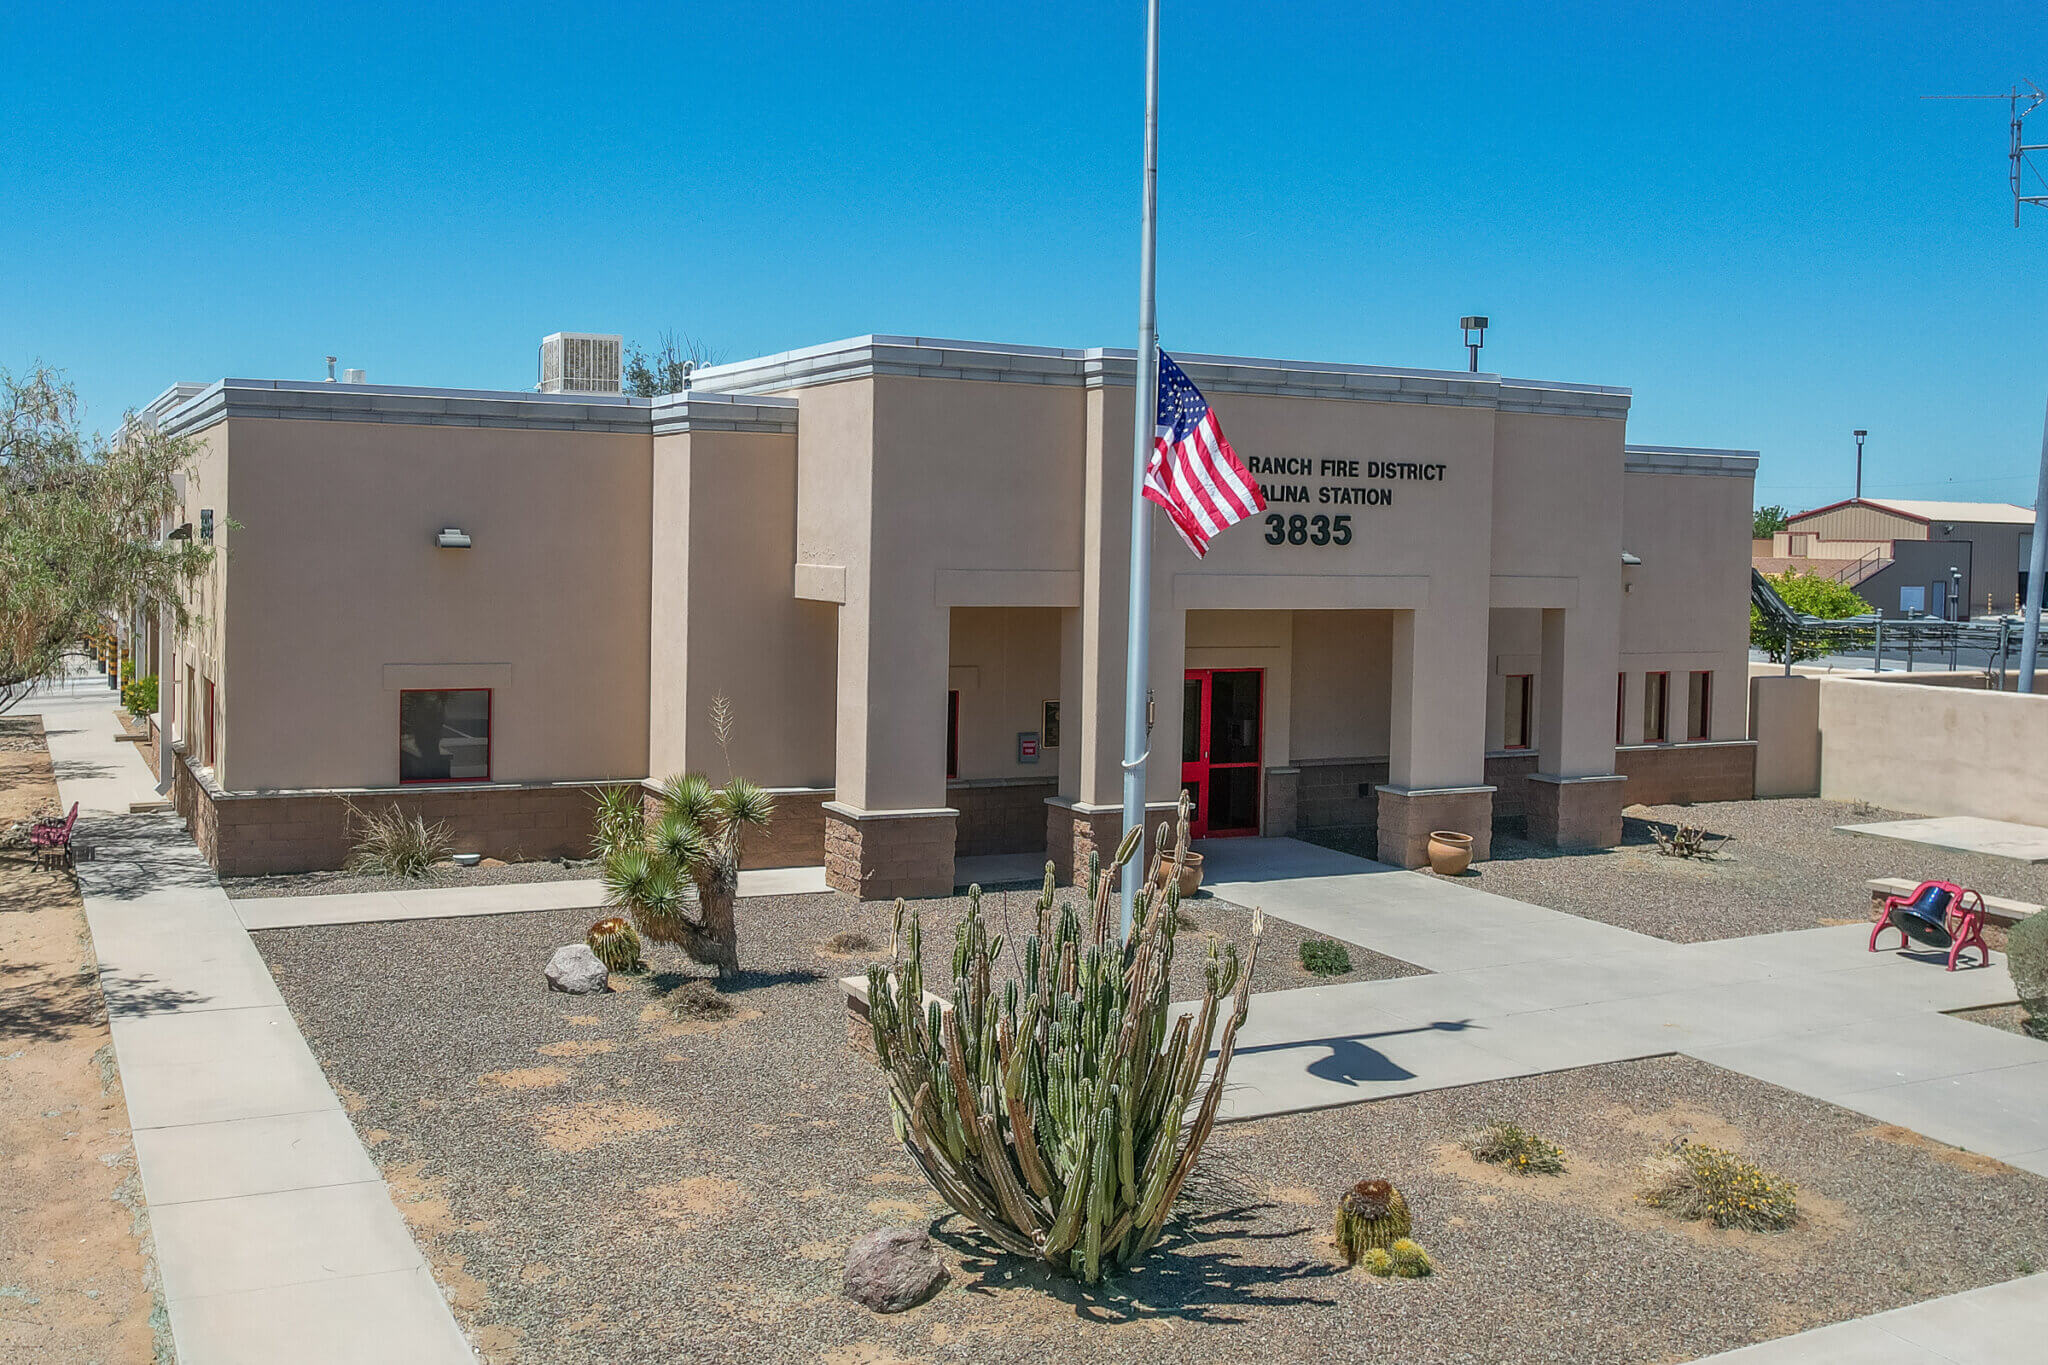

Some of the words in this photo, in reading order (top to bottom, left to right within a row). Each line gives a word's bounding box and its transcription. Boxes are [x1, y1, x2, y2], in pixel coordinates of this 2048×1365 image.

[1249, 456, 1312, 475] RANCH
[1320, 460, 1359, 478] FIRE
[1368, 462, 1447, 481] DISTRICT
[1258, 484, 1310, 503] ALINA
[1319, 487, 1392, 505] STATION
[1264, 513, 1353, 546] 3835
